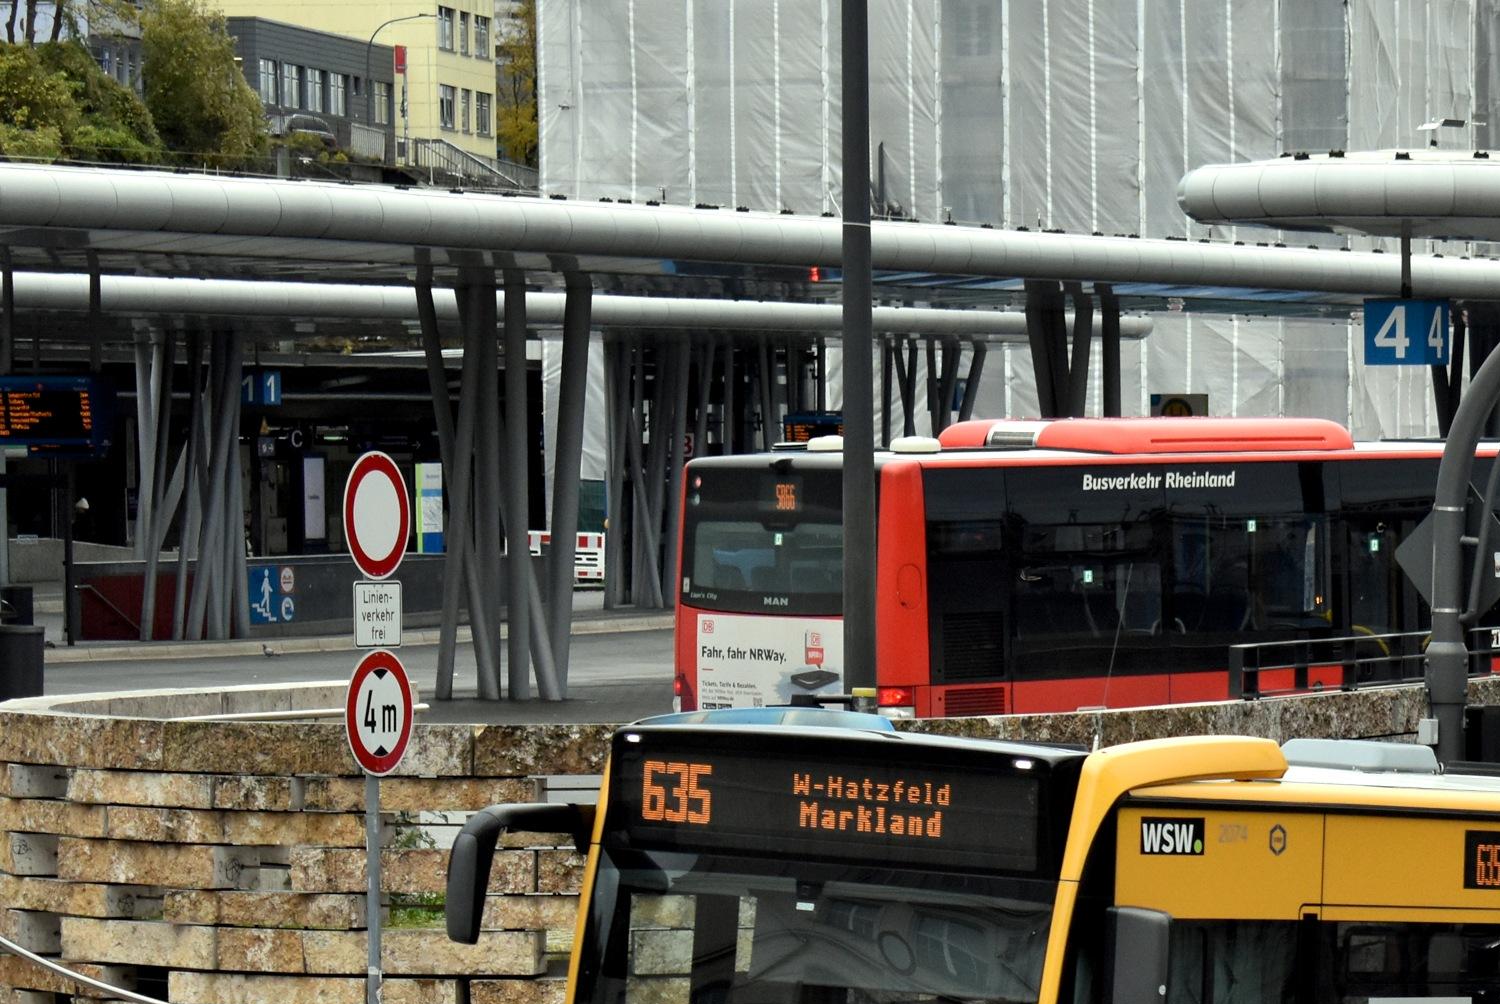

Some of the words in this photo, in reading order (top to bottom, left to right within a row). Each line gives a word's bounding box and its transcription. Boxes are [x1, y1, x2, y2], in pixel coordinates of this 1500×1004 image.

[1374, 306, 1410, 358] 4
[1428, 306, 1443, 358] 4
[242, 375, 254, 402] 1
[267, 375, 275, 402] 1
[291, 430, 303, 448] C
[1083, 472, 1162, 491] Busverkehr
[1166, 470, 1236, 489] Rheinland
[363, 590, 393, 604] Linien-
[707, 592, 717, 601] City
[763, 597, 789, 606] MAN
[362, 610, 395, 622] verkehr
[371, 627, 386, 640] frei
[702, 620, 714, 633] DB
[702, 646, 725, 660] Fahr,
[727, 646, 747, 660] fahr
[749, 649, 787, 665] NRWay.
[364, 690, 377, 733] 4
[382, 704, 397, 733] m
[642, 761, 712, 825] 635
[793, 773, 950, 807] W-Hatzfeld
[800, 802, 942, 838] Markland
[1218, 824, 1249, 844] 2074
